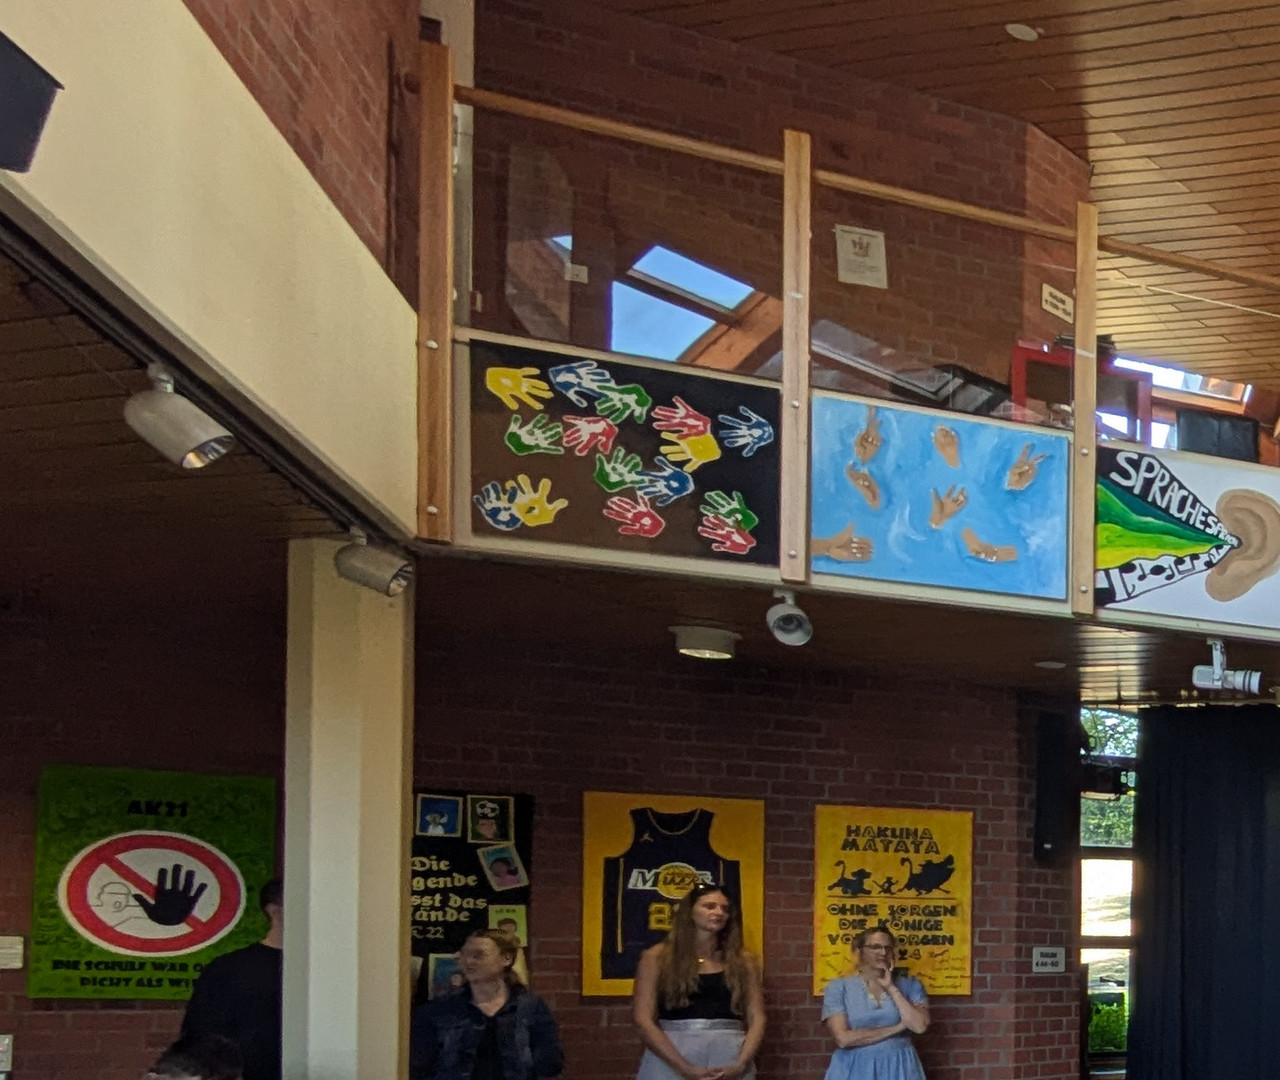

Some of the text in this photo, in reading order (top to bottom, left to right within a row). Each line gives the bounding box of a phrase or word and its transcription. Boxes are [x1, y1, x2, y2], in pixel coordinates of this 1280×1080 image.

[846, 825, 933, 840] HAKUNA
[841, 838, 940, 854] MATATA
[411, 856, 451, 871] Die
[412, 873, 478, 891] gende
[413, 907, 471, 922] ände
[827, 904, 957, 917] OHNE SORGEN
[839, 914, 943, 931] DIE KÖNIGE
[828, 934, 954, 946] VO ORGEN
[84, 960, 147, 971] SCHULE
[151, 961, 189, 972] WAR
[135, 977, 163, 988] ALS
